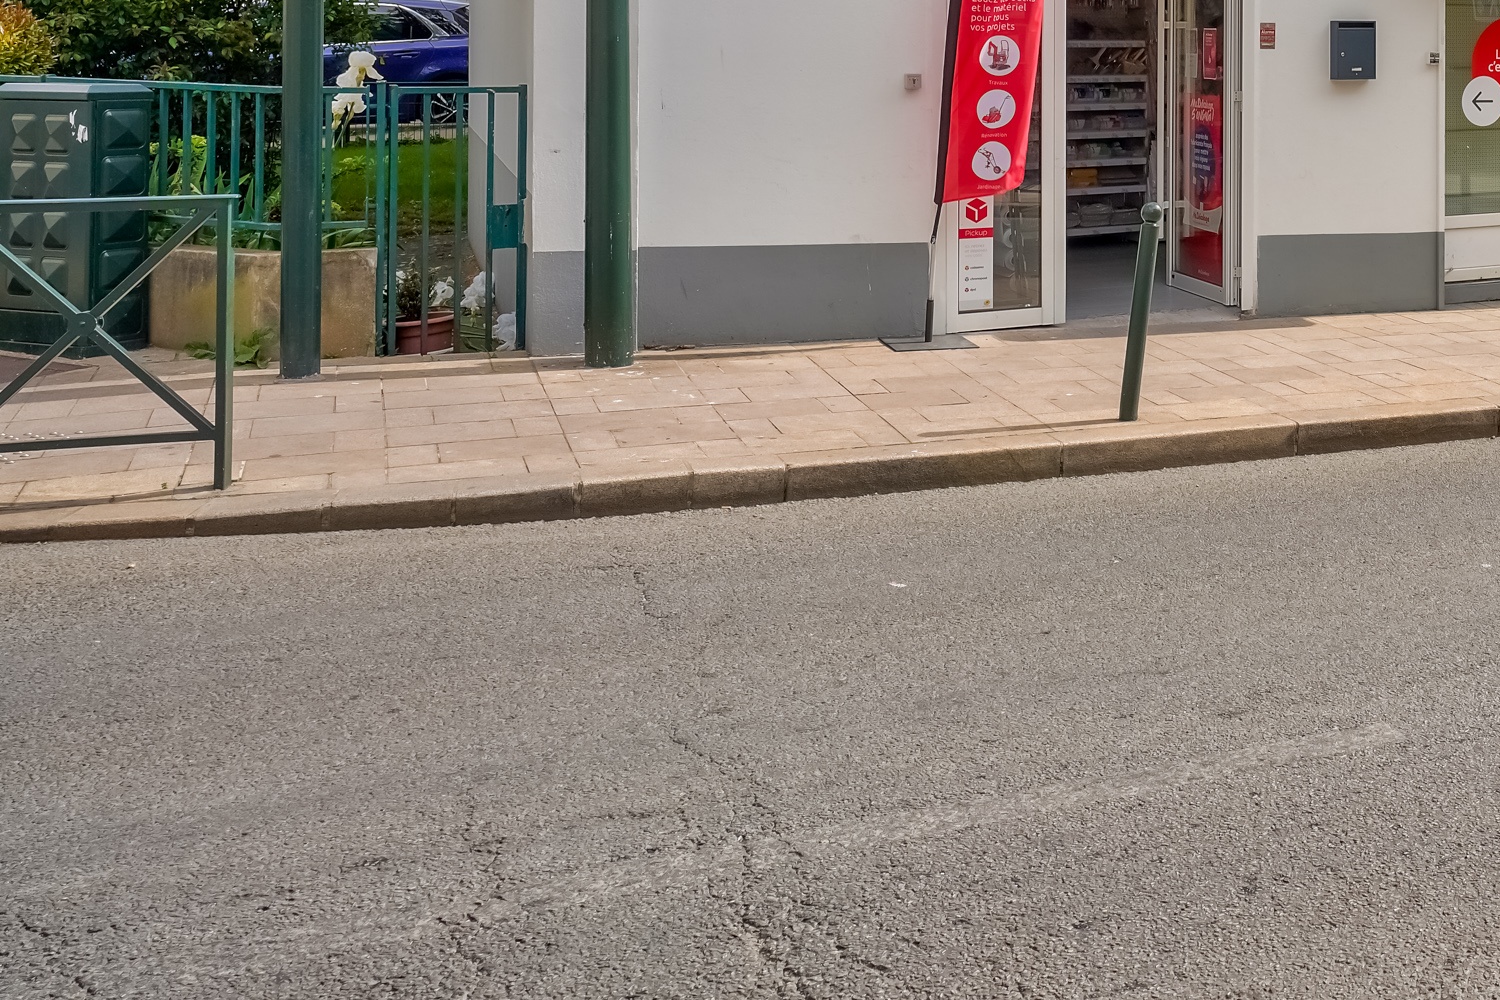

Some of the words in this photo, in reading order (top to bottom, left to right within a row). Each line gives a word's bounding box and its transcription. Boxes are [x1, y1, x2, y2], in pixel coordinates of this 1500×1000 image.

[971, 4, 981, 12] et
[982, 4, 991, 13] le
[993, 2, 1027, 13] matériel
[970, 14, 992, 23] pour
[993, 13, 1010, 22] tous
[970, 24, 985, 32] vos
[986, 21, 1015, 33] projets
[964, 229, 988, 237] Pickup
